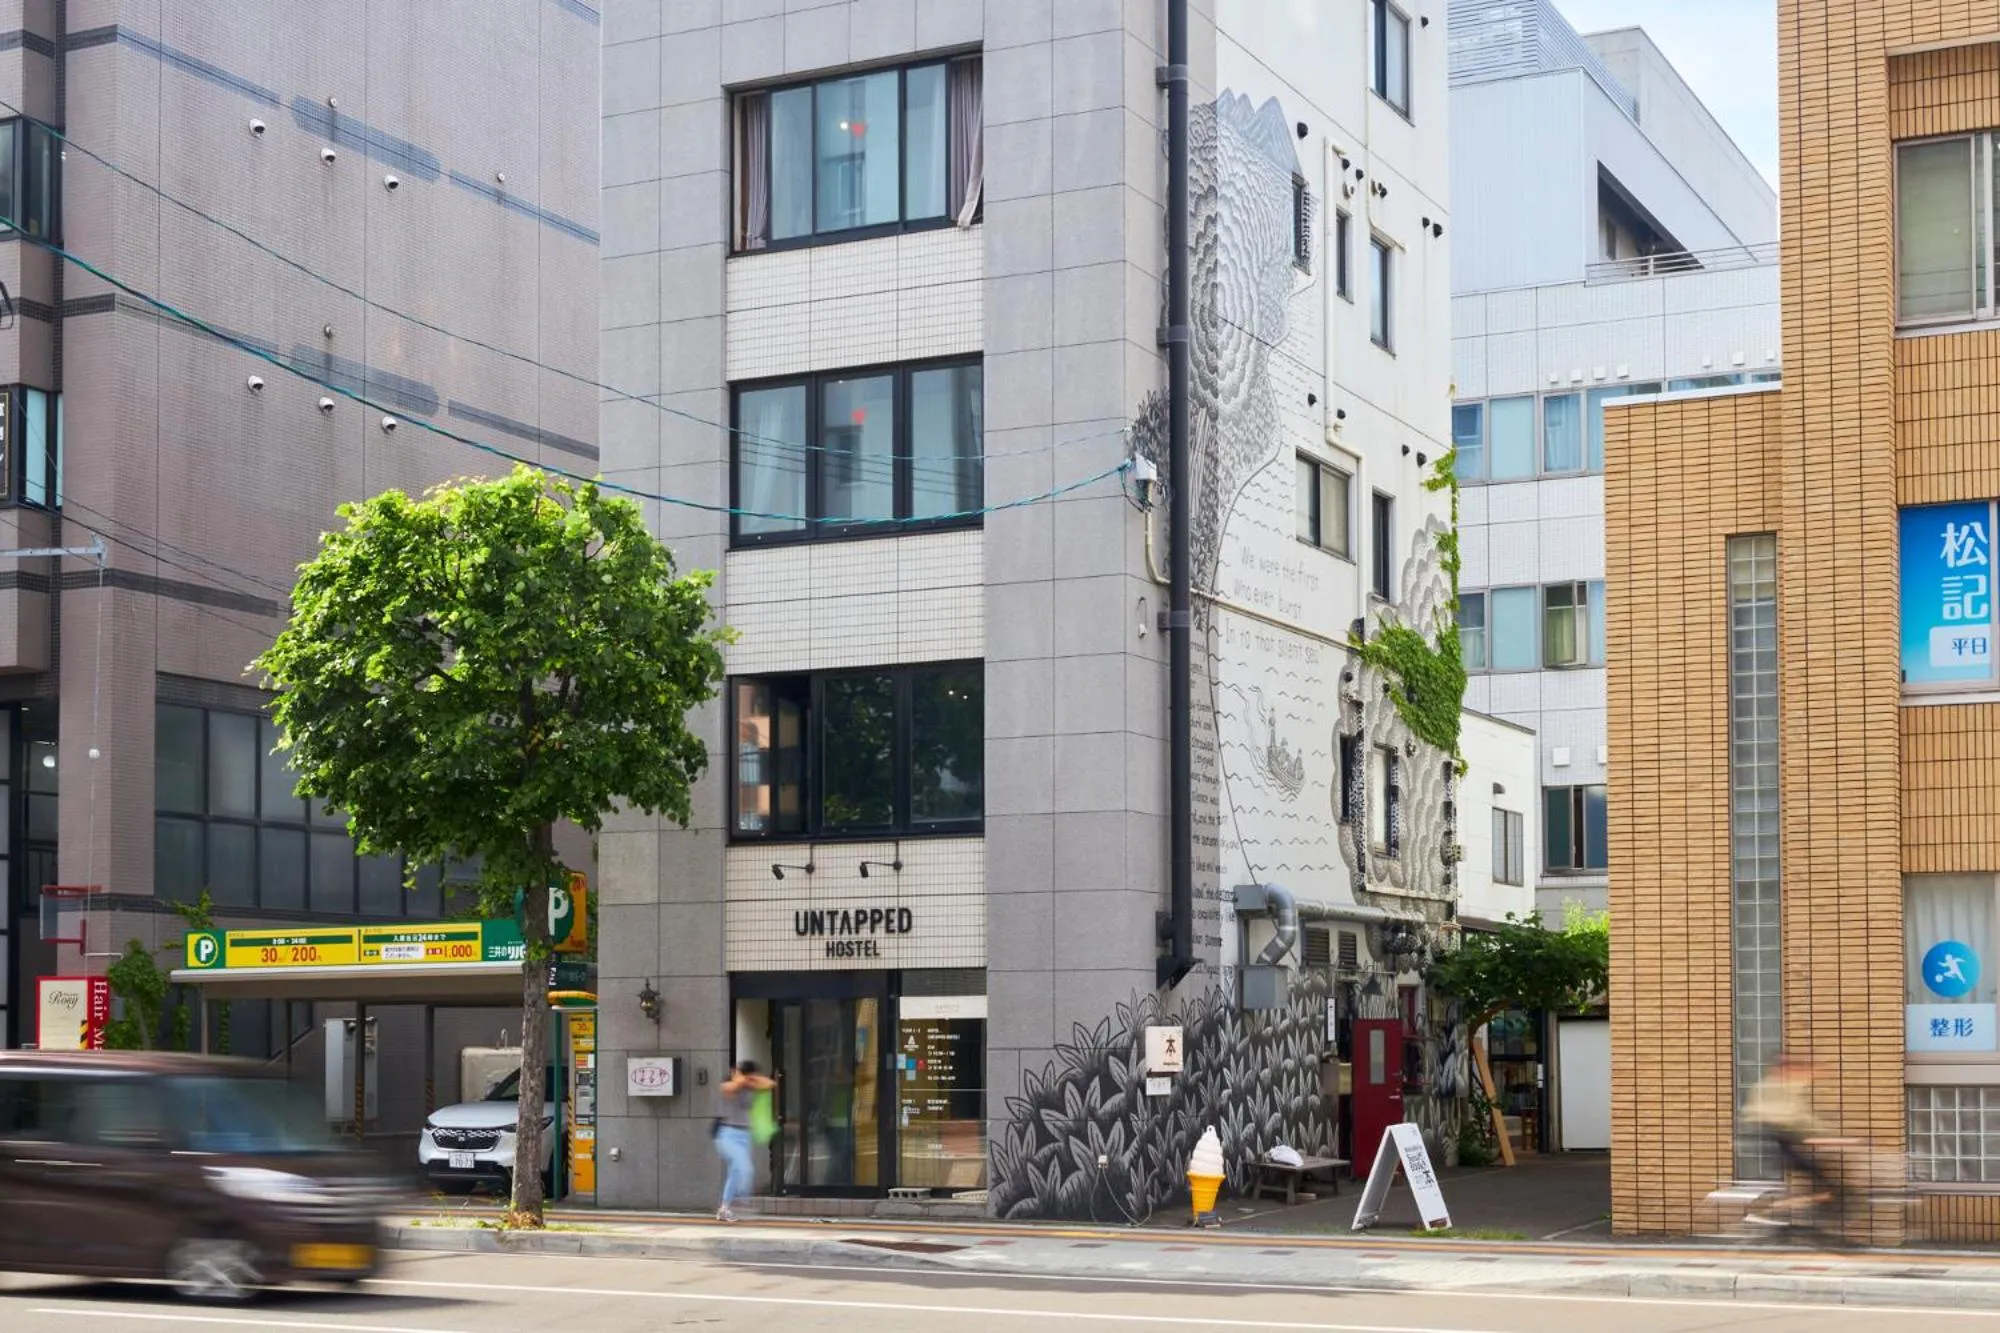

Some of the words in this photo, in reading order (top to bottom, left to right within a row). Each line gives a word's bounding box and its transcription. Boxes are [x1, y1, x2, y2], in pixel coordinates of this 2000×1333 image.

[1952, 637, 1987, 656] 平日
[547, 887, 569, 936] P
[795, 907, 913, 936] UNTAPPED
[200, 940, 214, 962] P
[826, 939, 880, 957] HOSTEL
[94, 981, 108, 1020] Hair
[1930, 1017, 1974, 1037] 整形
